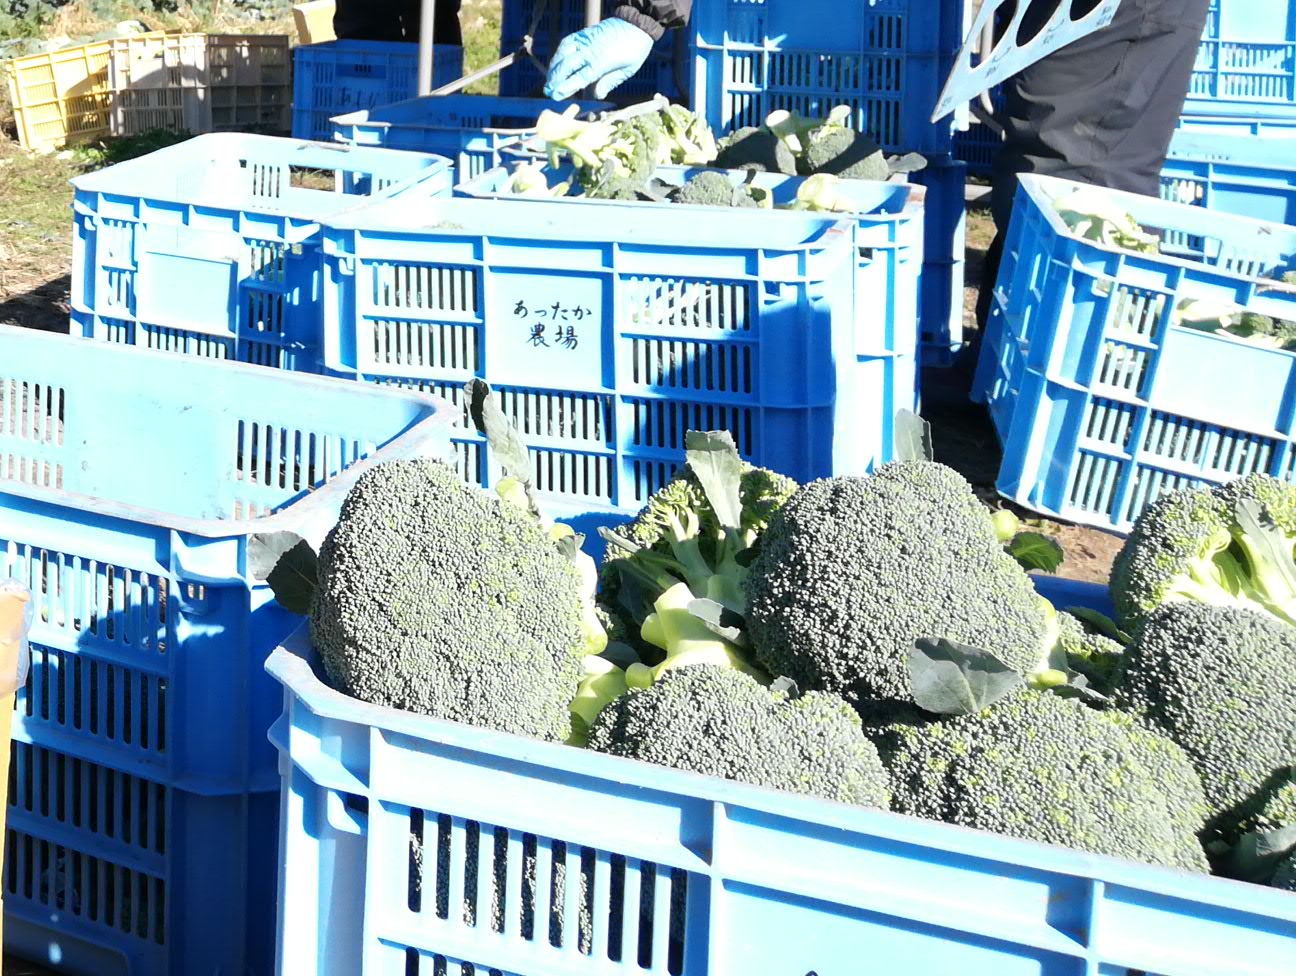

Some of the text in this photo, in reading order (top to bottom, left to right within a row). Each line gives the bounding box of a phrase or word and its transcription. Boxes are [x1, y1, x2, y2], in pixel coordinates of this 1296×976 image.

[513, 299, 593, 321] あったか
[525, 322, 579, 351] 農場
